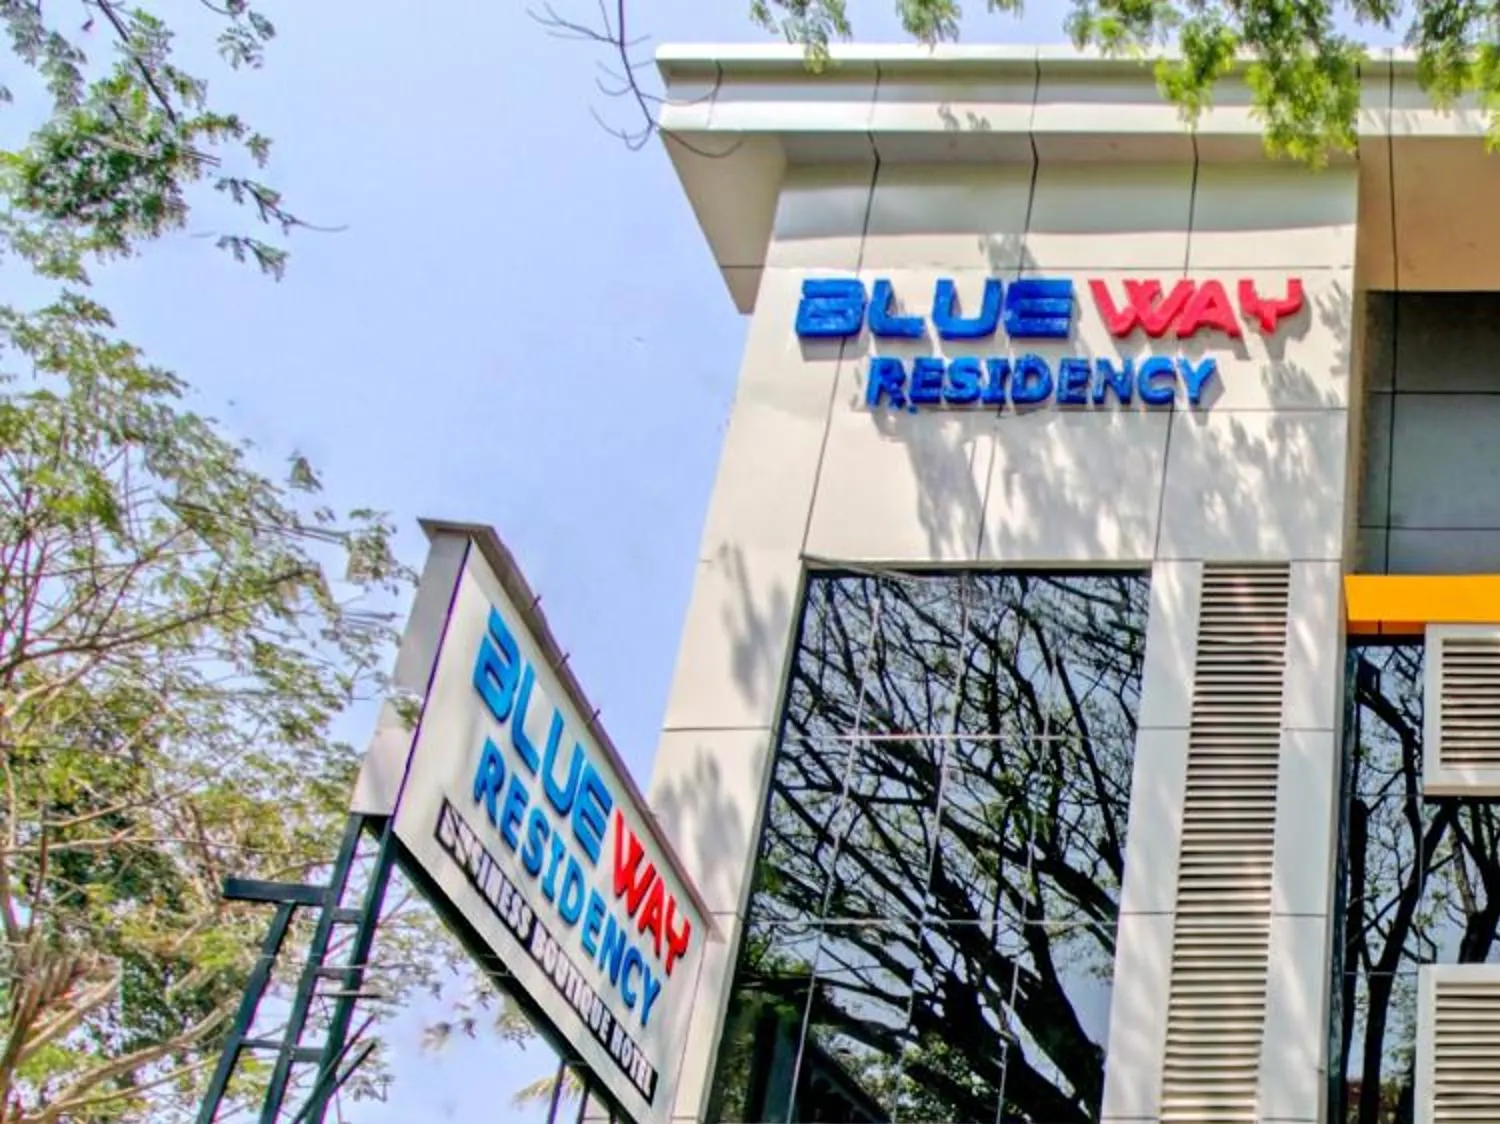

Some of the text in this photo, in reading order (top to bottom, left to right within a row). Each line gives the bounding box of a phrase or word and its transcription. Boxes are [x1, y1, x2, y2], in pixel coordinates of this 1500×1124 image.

[796, 278, 1303, 340] BLUE WAY
[866, 353, 1217, 412] RESIDENCY
[472, 603, 691, 978] BLUE WAY
[473, 735, 662, 1027] RESIDENCY
[530, 919, 612, 1046] BOUTIQUE
[609, 1020, 653, 1098] HOTEL
